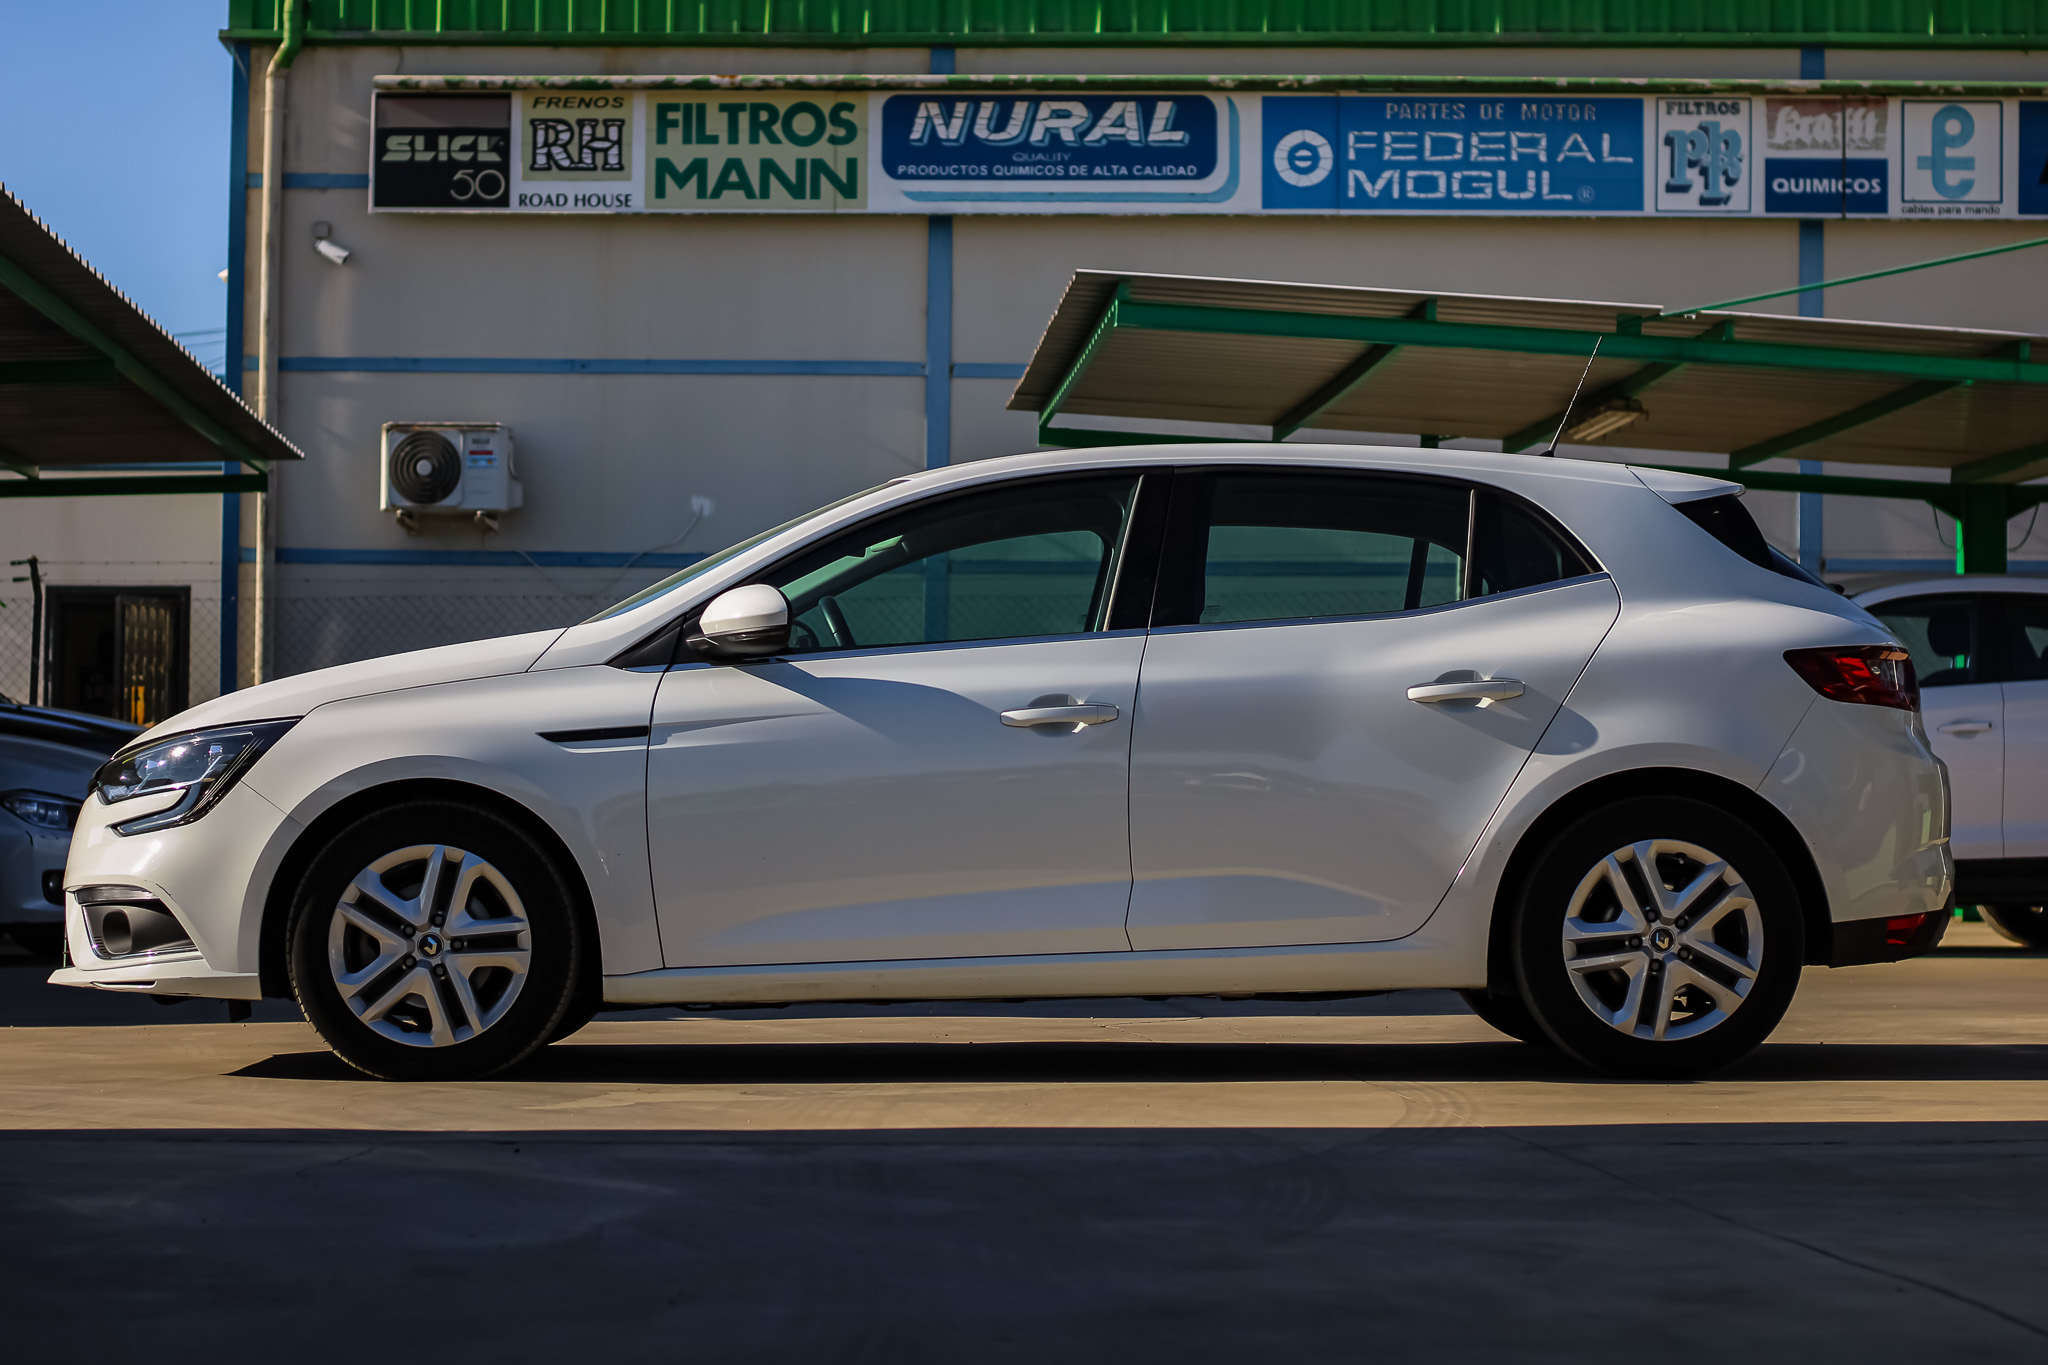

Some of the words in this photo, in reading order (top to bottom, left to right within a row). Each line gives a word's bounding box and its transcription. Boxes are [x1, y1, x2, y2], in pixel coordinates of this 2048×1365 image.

[532, 96, 625, 109] FRENOS
[1386, 102, 1466, 121] PARTES
[1480, 103, 1505, 121] DE
[1521, 103, 1597, 121] MOTOR
[1666, 101, 1741, 115] FILTROS
[655, 101, 858, 147] FILTROS
[909, 100, 1190, 146] NURAL
[381, 134, 503, 162] SLICK
[529, 118, 626, 172] RH
[1348, 131, 1634, 163] FEDERAL
[1012, 152, 1071, 162] QUALITY
[654, 156, 858, 201] MANN
[898, 164, 989, 176] PRODUCTOS
[992, 165, 1065, 178] QUIMICOS
[1069, 165, 1089, 176] DE
[1093, 165, 1129, 176] ALTA
[1132, 165, 1198, 176] CALIDAD
[450, 169, 505, 201] 50
[1348, 169, 1573, 200] MOGUL
[1772, 177, 1882, 195] QUIMICOS
[518, 193, 568, 208] ROAD
[573, 193, 632, 208] HOUSE
[1901, 204, 1935, 215] cables
[1938, 207, 1962, 216] para
[1965, 204, 2001, 215] mando
